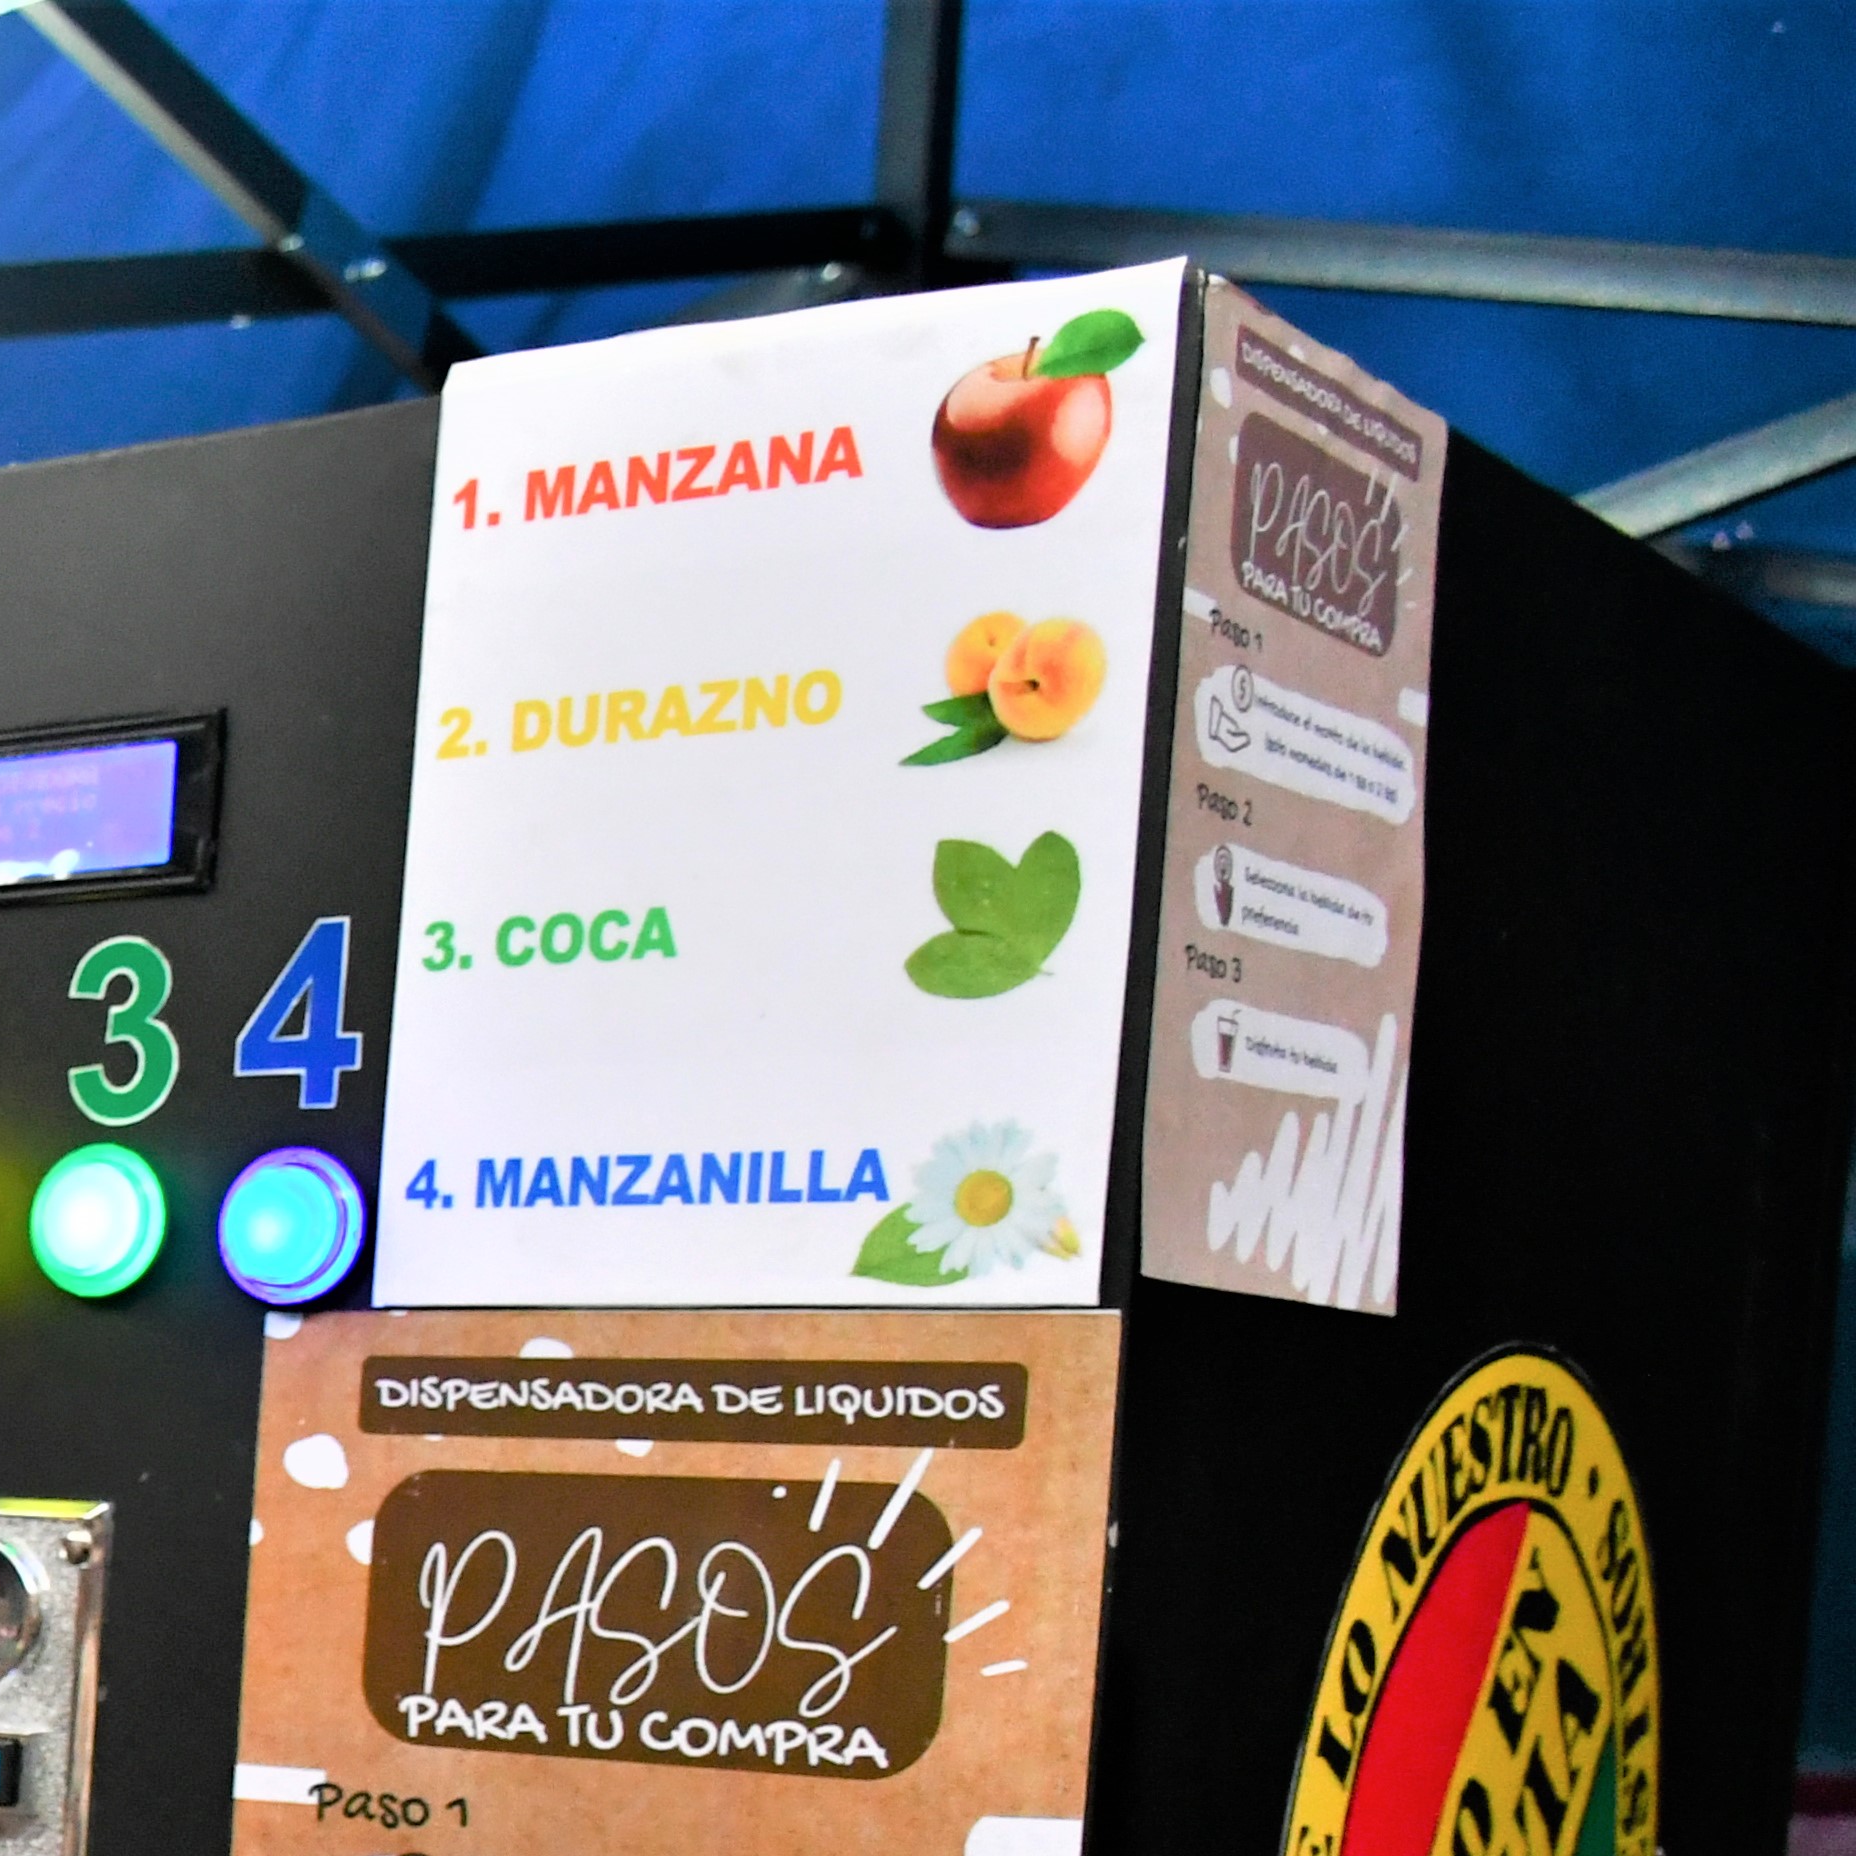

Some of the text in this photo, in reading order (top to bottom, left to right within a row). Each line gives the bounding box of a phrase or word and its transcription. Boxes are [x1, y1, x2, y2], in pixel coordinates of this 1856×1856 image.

[452, 426, 863, 529] 1. MANZANA
[1249, 462, 1387, 617] PASOS
[1208, 608, 1250, 649] Paso
[1241, 560, 1382, 651] PARA TU COMPRA
[436, 671, 842, 758] 2. DURAZNO
[1196, 782, 1254, 827] Paso 2
[422, 907, 676, 970] 3. COCA
[1185, 943, 1243, 983] Paso 3
[68, 935, 179, 1126] 3
[234, 916, 362, 1109] 4
[405, 1149, 889, 1208] 4. MANZANILLA
[375, 1376, 1006, 1426] DISPENSADORA DE LIQUIDOS
[419, 1527, 897, 1719] PASOS
[1316, 1618, 1377, 1792] LO
[1380, 1383, 1575, 1625] NUESTRO
[1489, 1546, 1560, 1755] EN
[398, 1694, 888, 1769] PARA TU COMPRA
[308, 1782, 471, 1828] Paso 1
